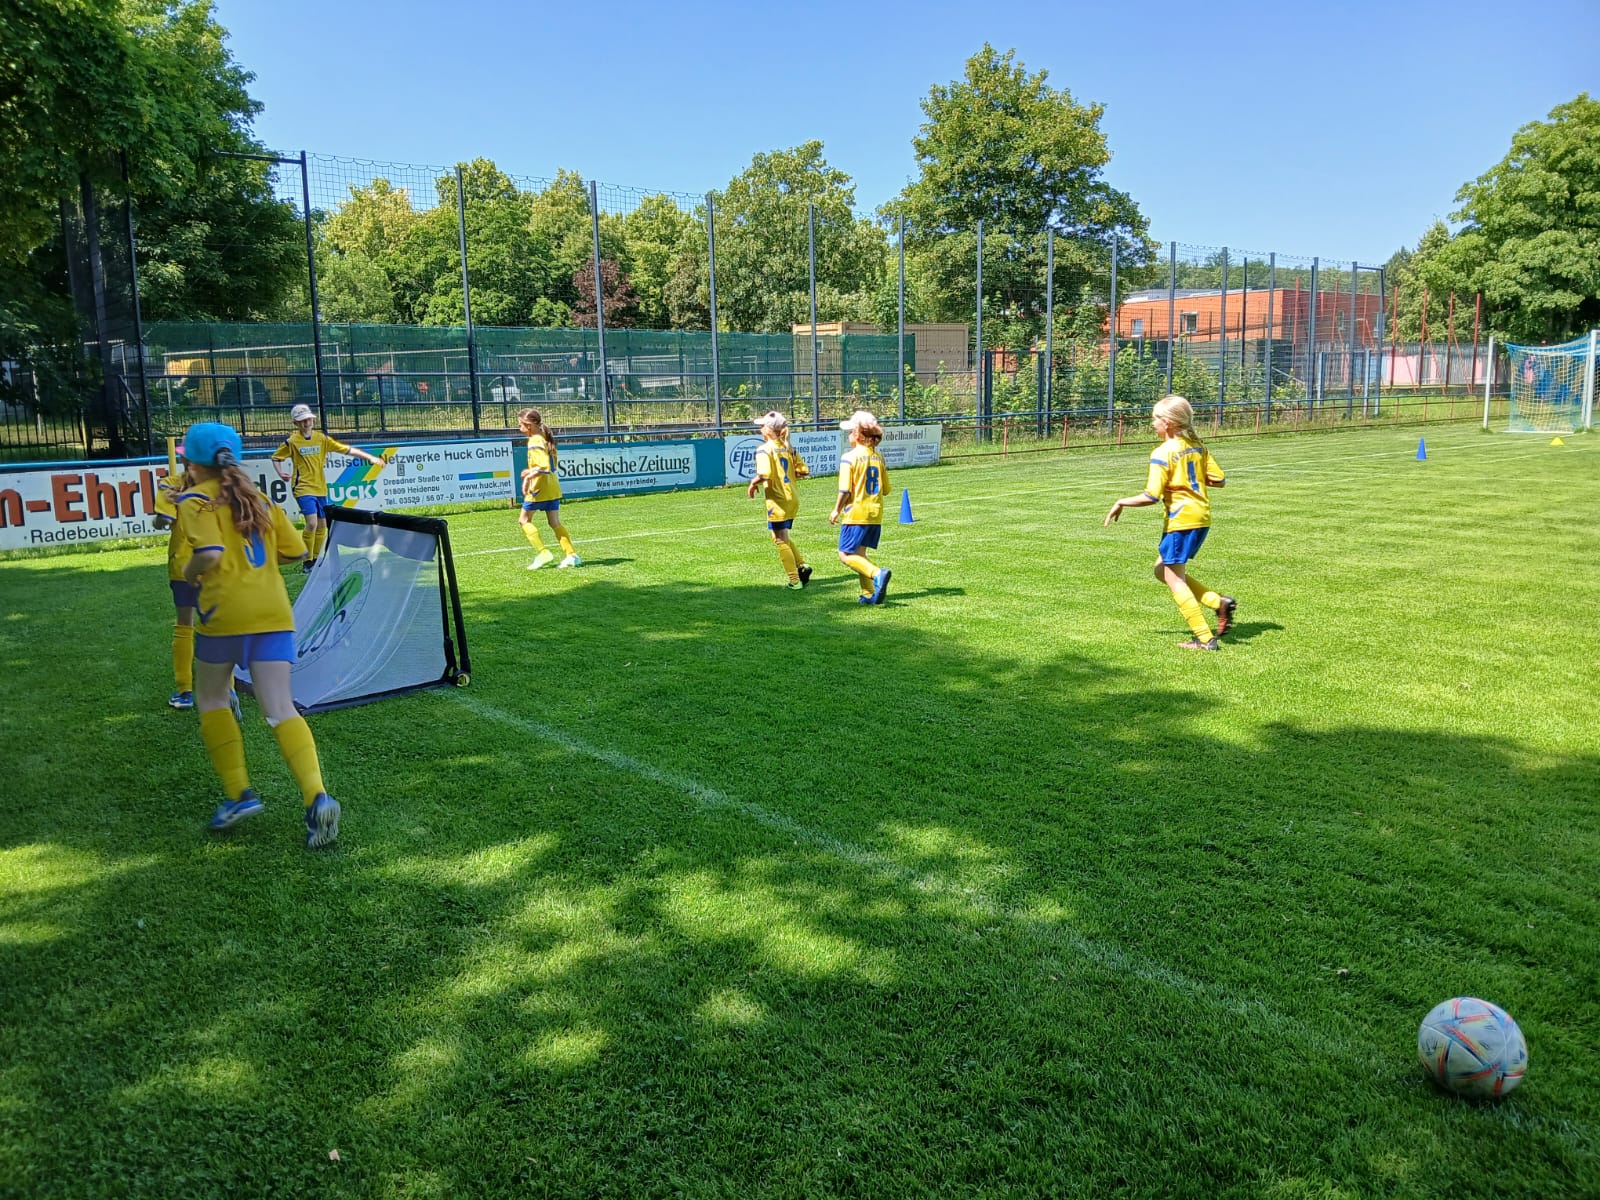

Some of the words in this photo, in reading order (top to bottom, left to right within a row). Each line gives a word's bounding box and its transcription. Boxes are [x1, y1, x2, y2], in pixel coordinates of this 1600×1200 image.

[884, 430, 923, 441] öbelhandel
[444, 449, 473, 461] Huck
[475, 447, 509, 459] GmbH
[557, 456, 637, 478] Sächsische
[638, 455, 690, 474] Zeitung
[383, 477, 416, 486] Dresdner
[417, 475, 440, 483] Straße
[458, 480, 511, 491] www.huck.net
[596, 480, 610, 488] Was
[865, 466, 880, 495] 8
[329, 484, 373, 502] UCK
[407, 485, 440, 494] Heidenau
[399, 496, 420, 505] 03529
